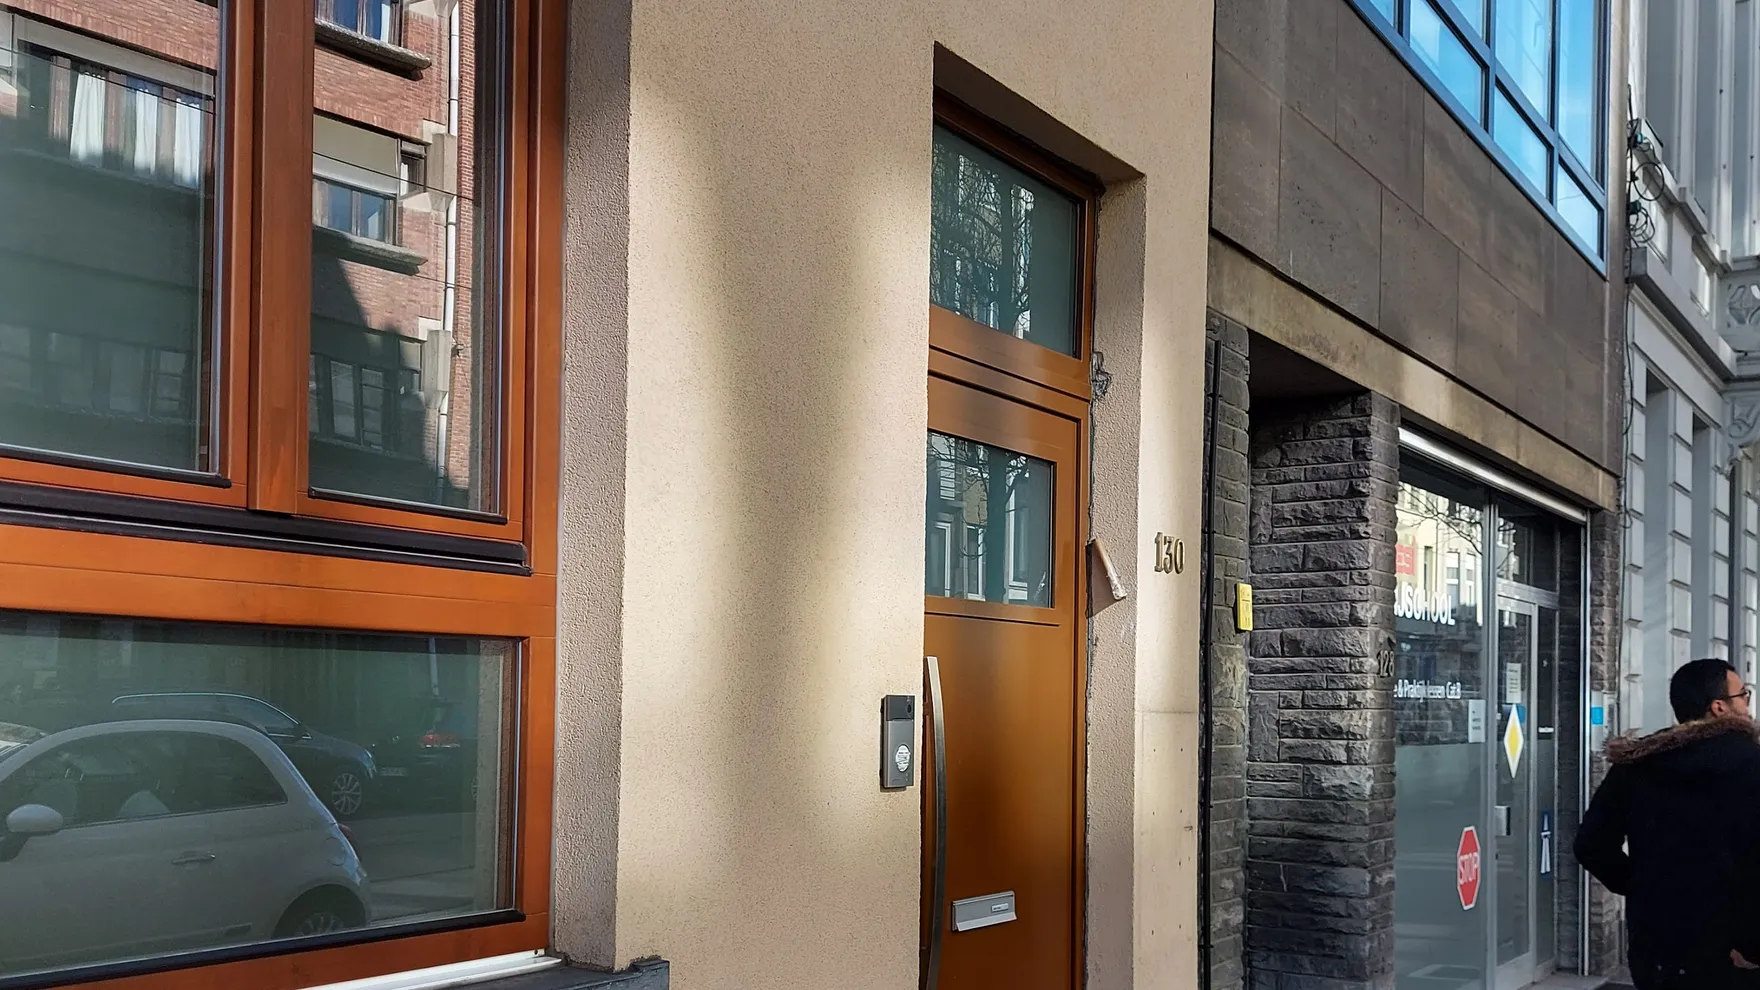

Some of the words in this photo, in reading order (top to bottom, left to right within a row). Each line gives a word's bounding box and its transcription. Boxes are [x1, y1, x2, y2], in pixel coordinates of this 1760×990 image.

[1154, 531, 1184, 574] 130
[1376, 650, 1395, 677] 128
[1459, 852, 1479, 885] STOP
